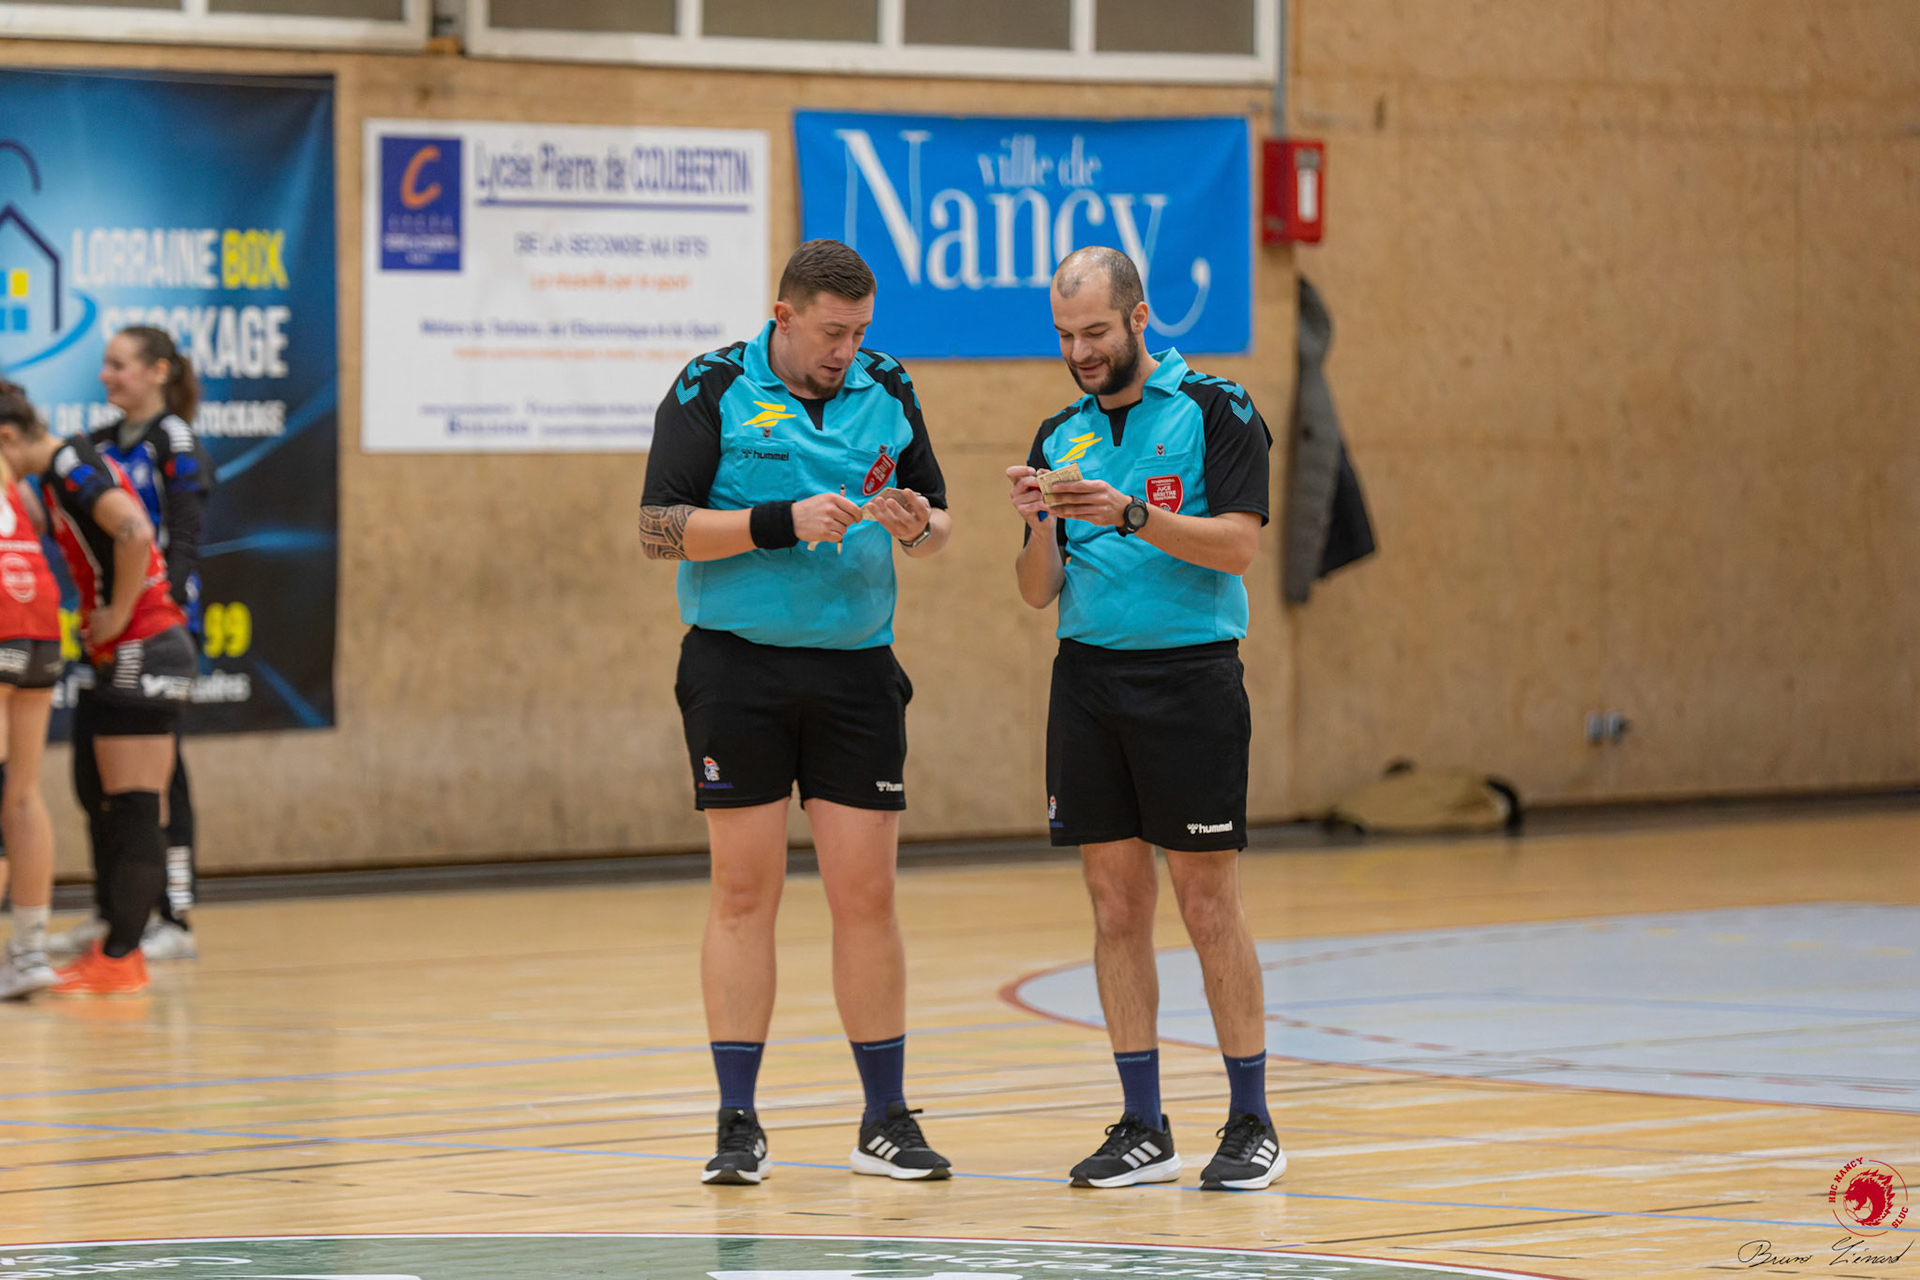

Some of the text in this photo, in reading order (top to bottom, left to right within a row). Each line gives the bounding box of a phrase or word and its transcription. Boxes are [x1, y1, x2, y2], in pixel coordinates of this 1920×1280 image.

[977, 133, 1102, 188] ville de
[834, 128, 1211, 338] Nancy
[71, 228, 291, 290] LORRAINE BOX
[753, 450, 789, 461] hummel
[1199, 820, 1233, 833] hummel
[0, 1256, 252, 1280] Carre
